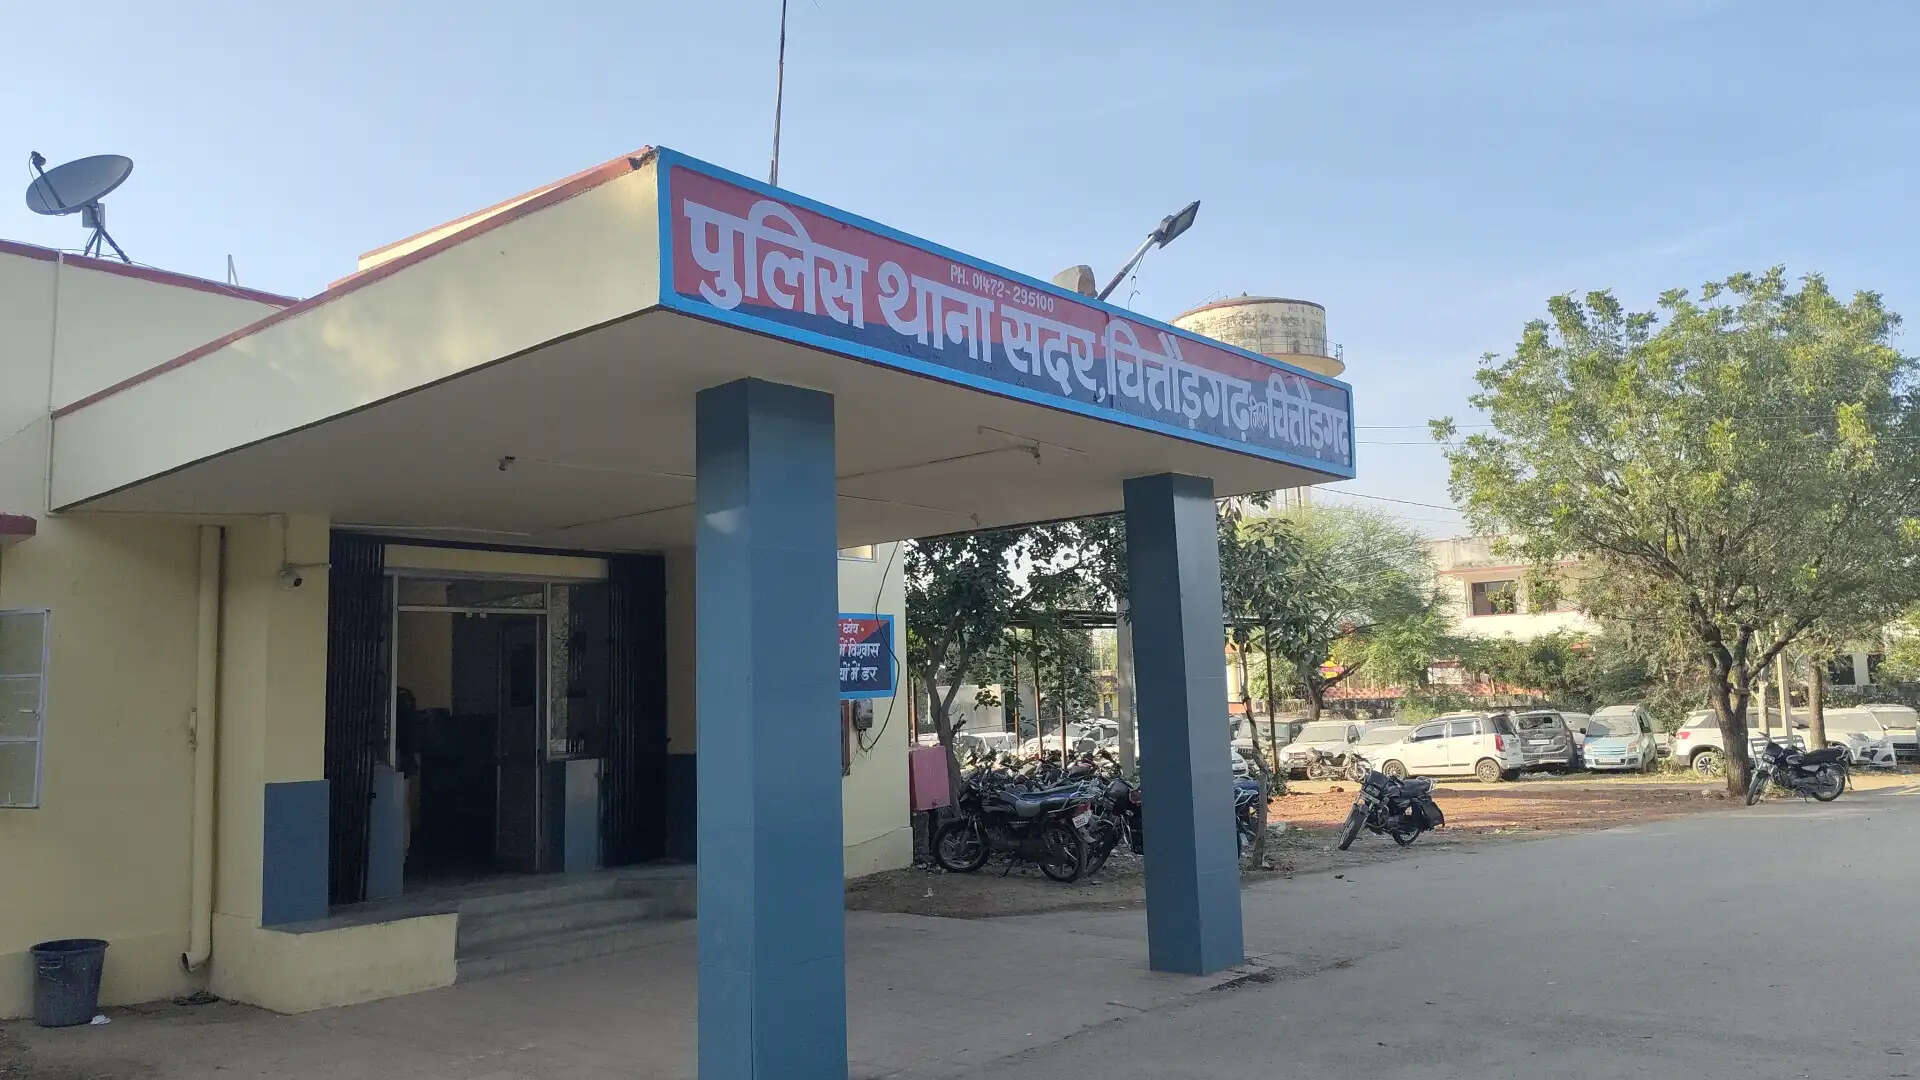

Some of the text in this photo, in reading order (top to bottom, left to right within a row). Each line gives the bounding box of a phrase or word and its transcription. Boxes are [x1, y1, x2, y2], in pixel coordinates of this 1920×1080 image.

[684, 199, 869, 330] पुलिस
[878, 260, 994, 363] थाना
[848, 638, 880, 659] विश्वास
[861, 667, 877, 681] डर
